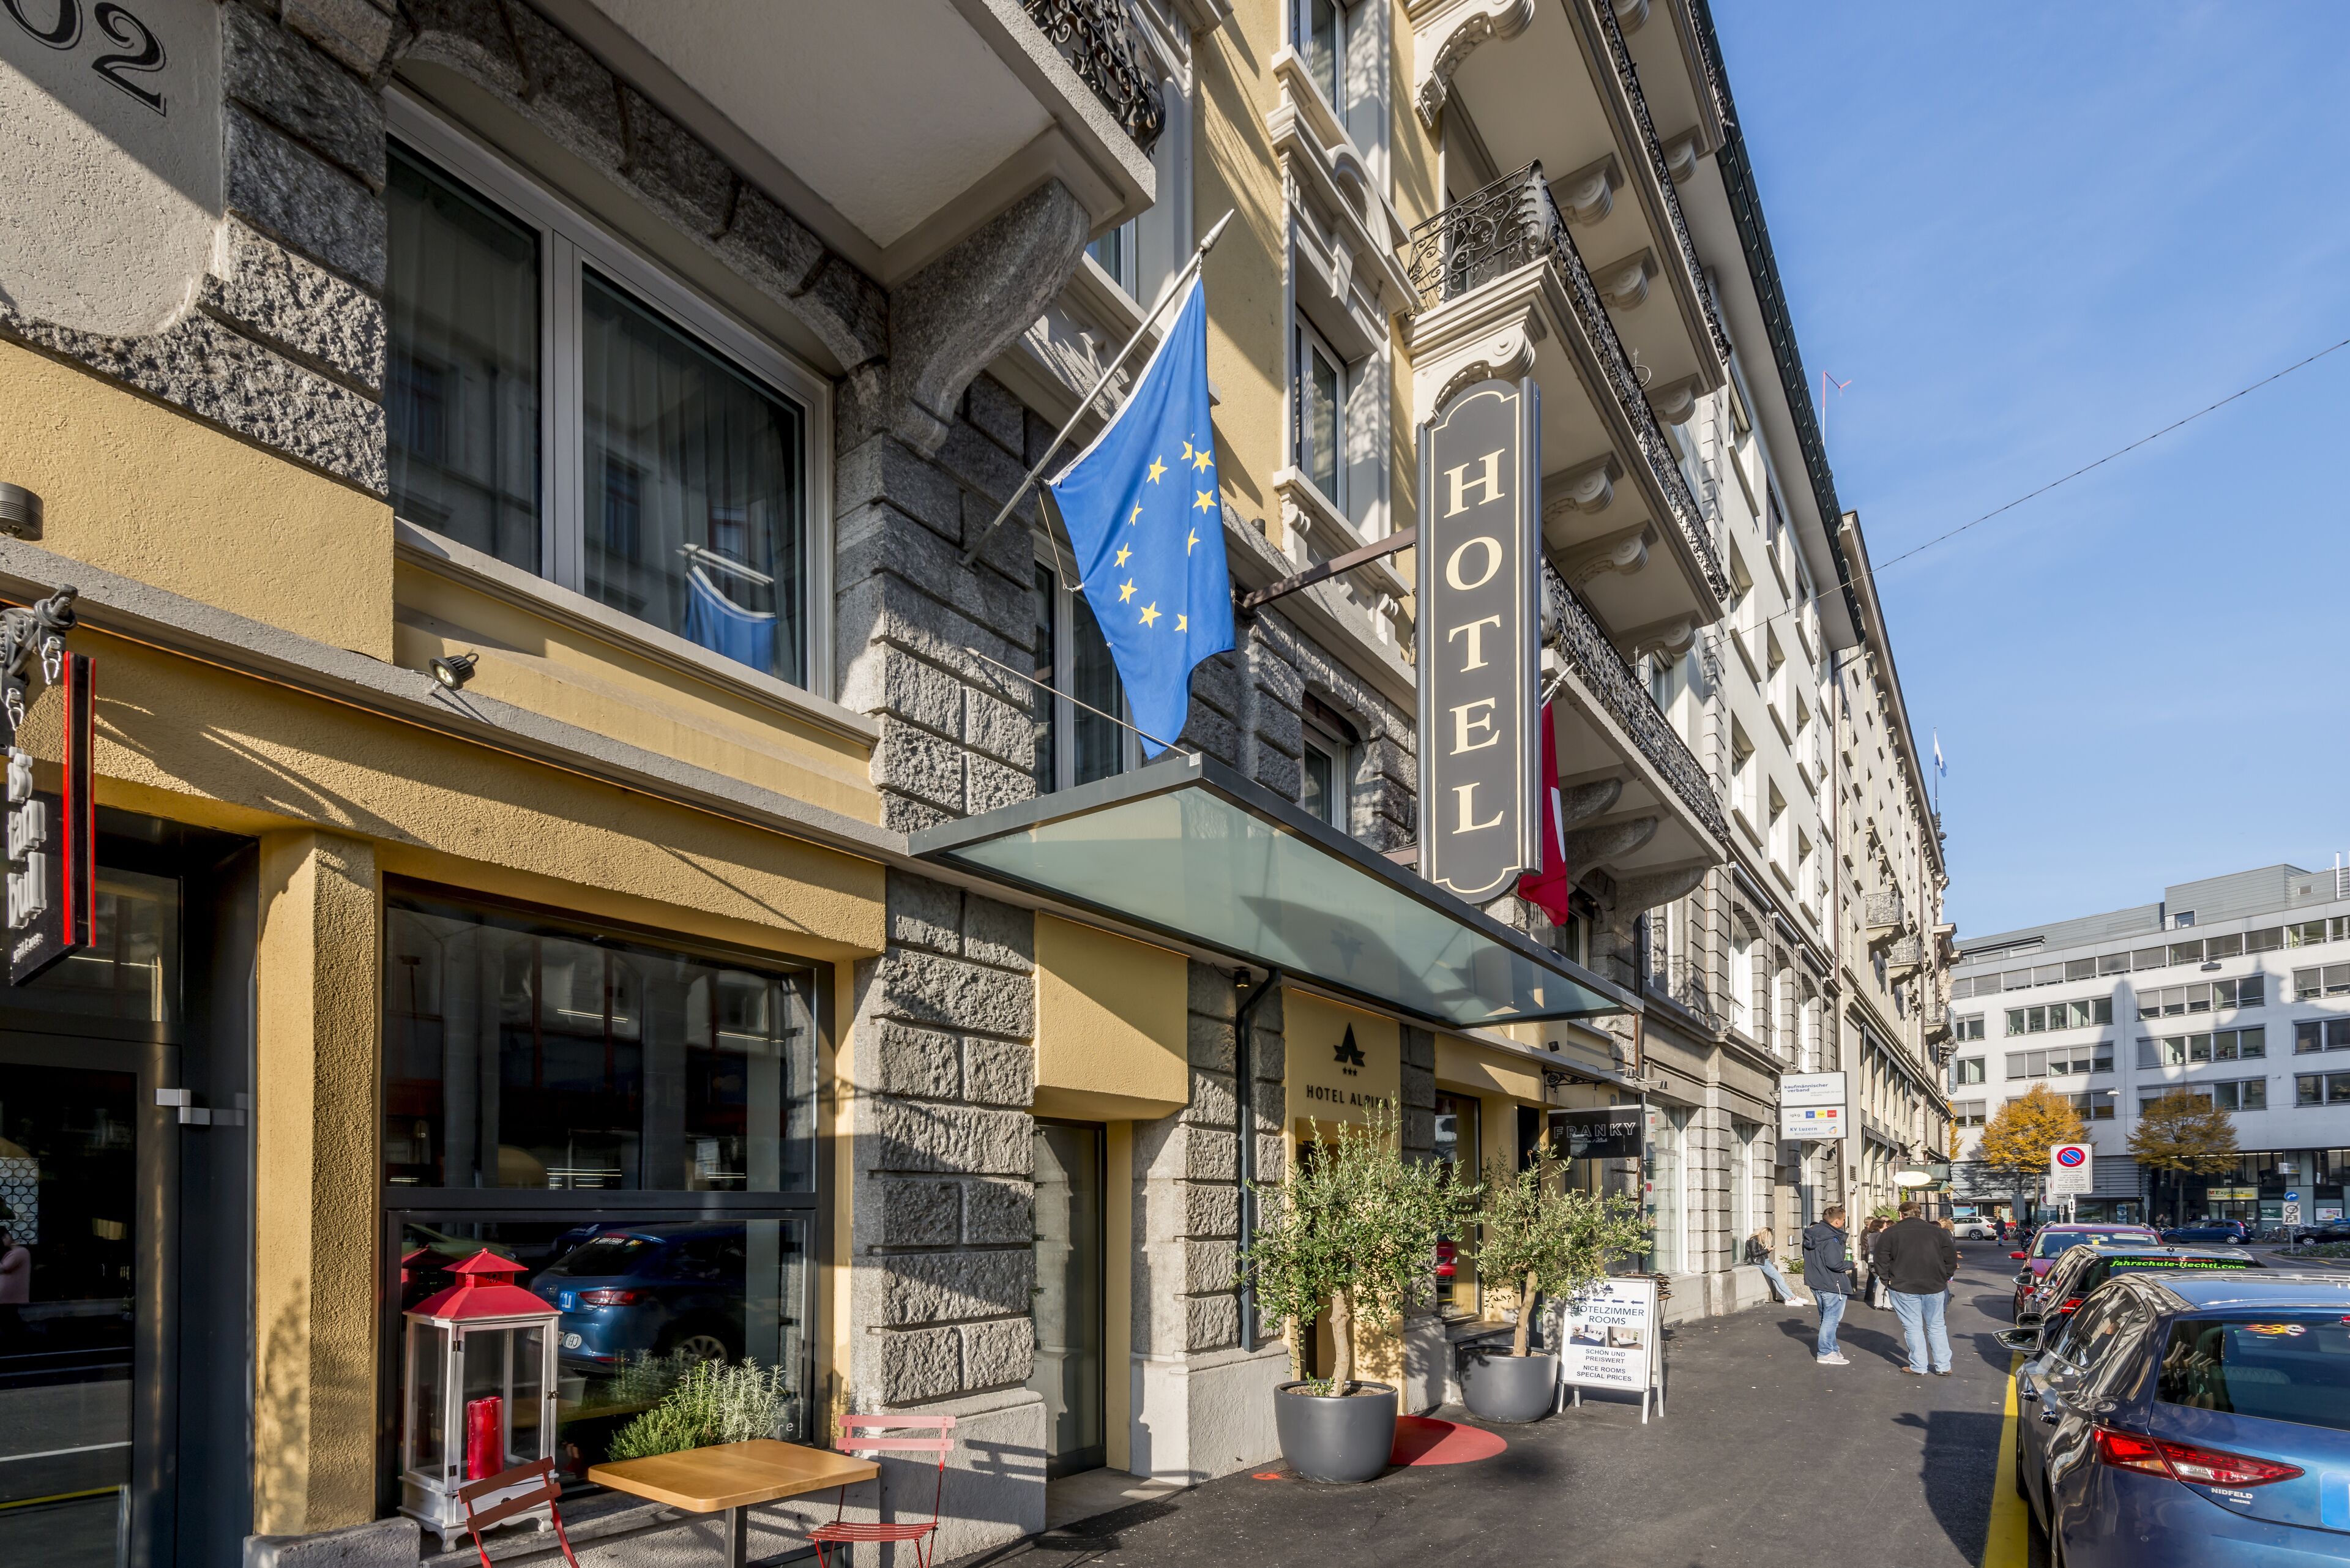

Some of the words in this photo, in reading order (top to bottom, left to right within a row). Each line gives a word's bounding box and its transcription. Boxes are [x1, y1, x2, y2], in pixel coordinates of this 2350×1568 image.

[1443, 448, 1505, 835] HOTEL
[1306, 1084, 1345, 1103] HOTEL
[1349, 1092, 1390, 1111] ALPINA
[1553, 1122, 1636, 1139] FRANKY
[1572, 1305, 1644, 1316] HOTELZIMMER
[1589, 1315, 1626, 1325] ROOMS
[1585, 1356, 1625, 1364] PREISWERT
[1576, 1371, 1605, 1379] SPECIAL
[2211, 1487, 2253, 1499] NIDFELD
